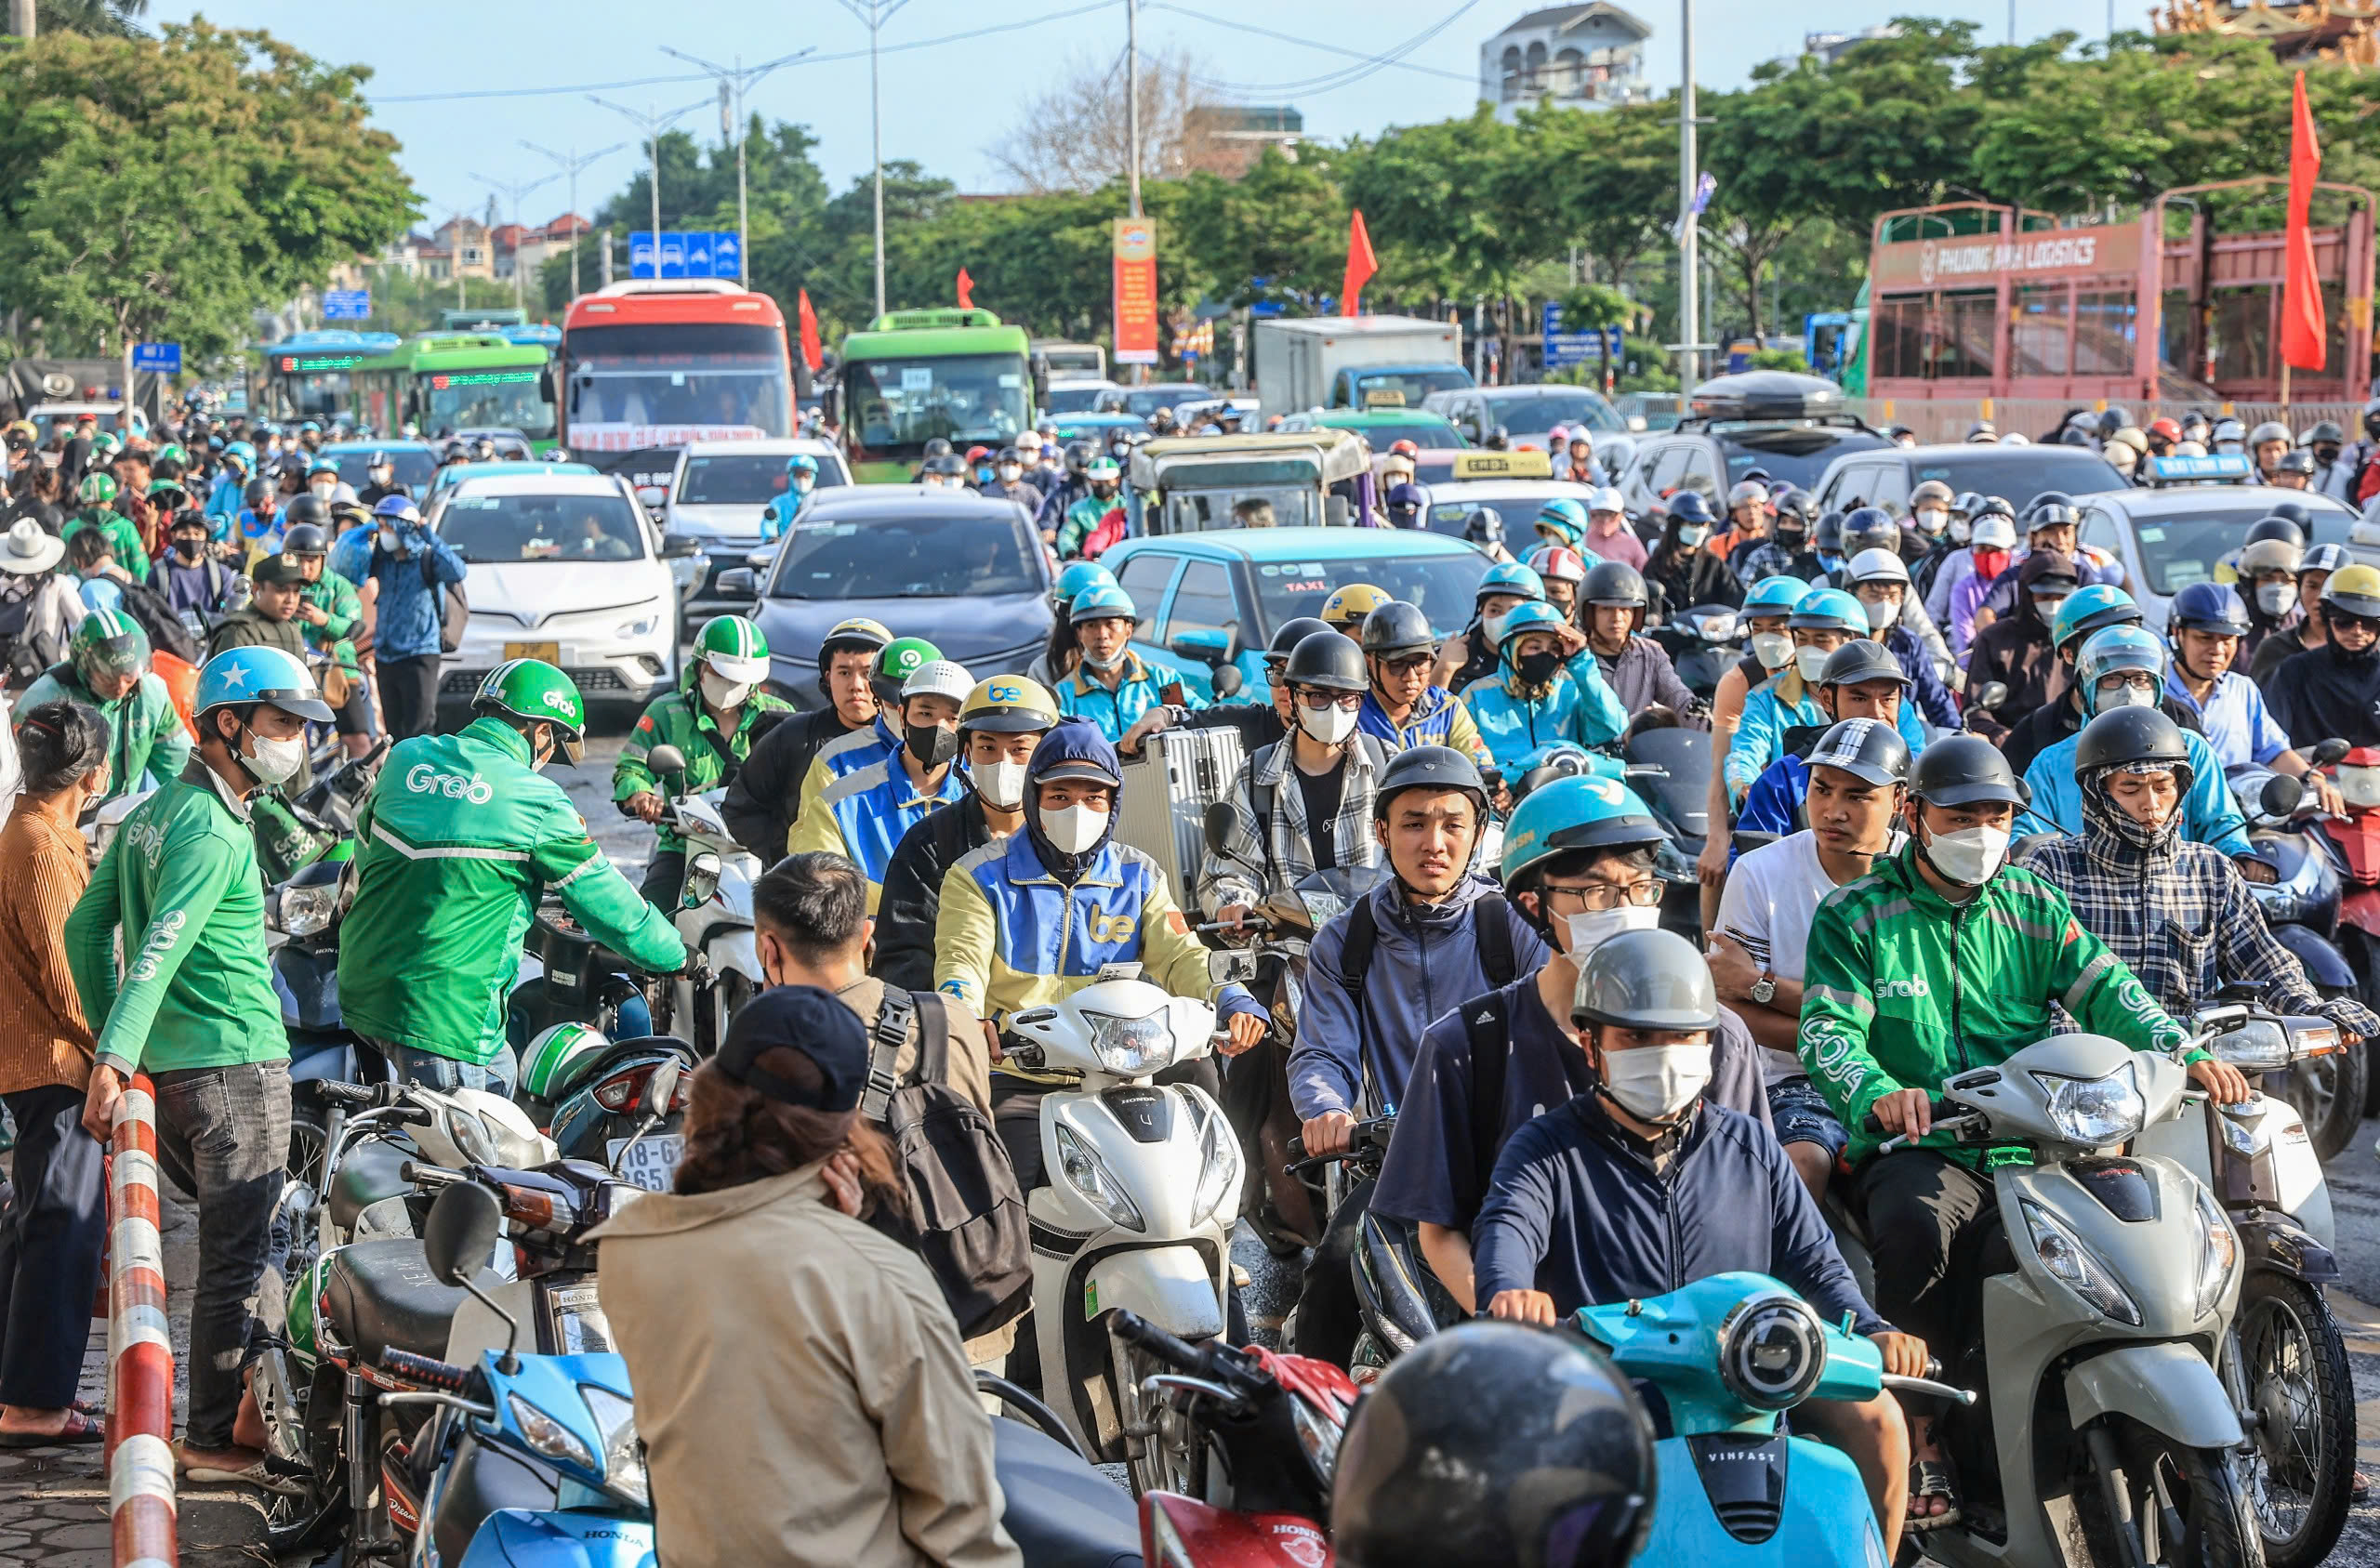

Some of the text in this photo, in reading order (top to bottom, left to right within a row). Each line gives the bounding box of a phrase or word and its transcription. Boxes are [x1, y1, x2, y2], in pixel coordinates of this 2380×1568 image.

[2025, 236, 2096, 270] LOGISTICS
[1285, 581, 1325, 592] TAXI
[110, 652, 135, 665] Grab
[542, 691, 576, 718] Grab
[988, 683, 1021, 703] be
[405, 763, 494, 805] Grab
[274, 824, 308, 853] Grab
[1089, 904, 1136, 943] be
[128, 909, 187, 982] Grab
[1873, 974, 1929, 999] Grab
[1798, 1015, 1870, 1104] Grab
[1121, 1097, 1157, 1105] HONDA
[373, 1373, 395, 1390] HONDA
[1708, 1451, 1776, 1463] VINFAST
[389, 1497, 420, 1522] Dream
[585, 1530, 644, 1548] HONDA
